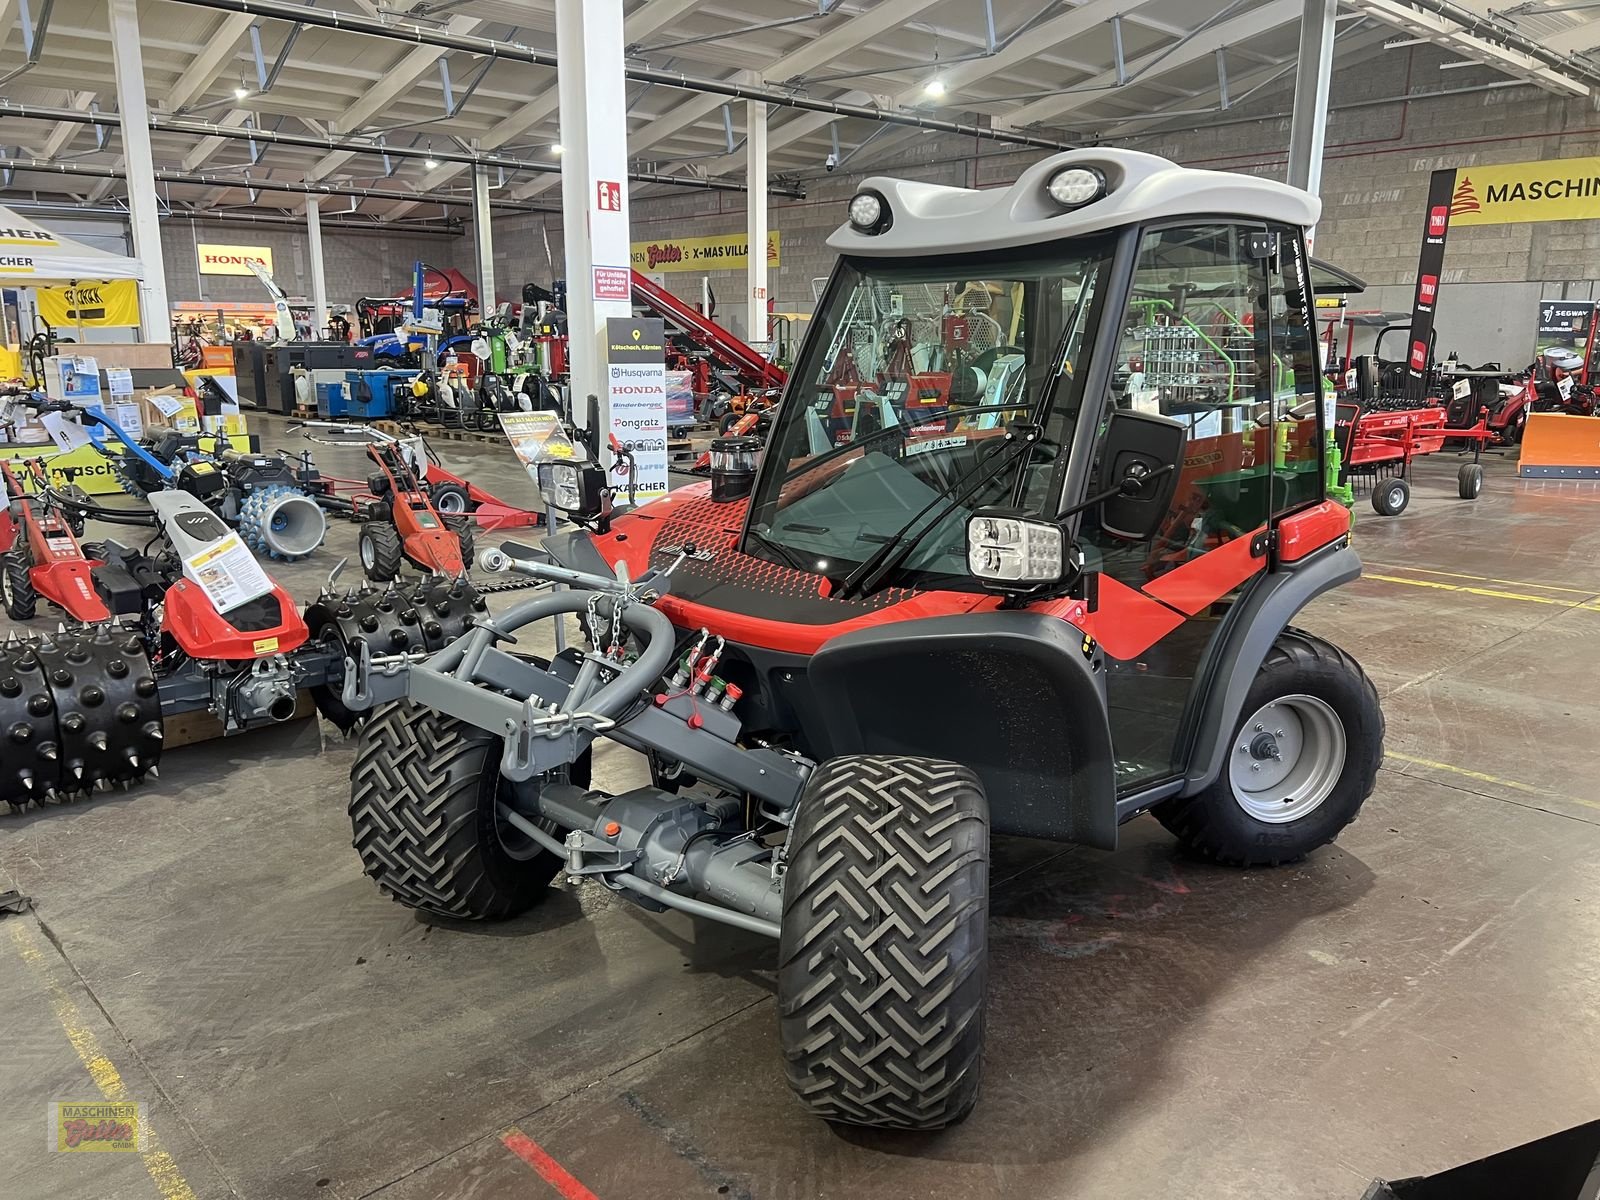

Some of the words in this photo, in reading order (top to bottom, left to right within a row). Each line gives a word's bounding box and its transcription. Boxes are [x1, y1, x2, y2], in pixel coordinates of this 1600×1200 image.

[621, 368, 663, 378] Husqvarna
[612, 386, 663, 394] HONDA
[614, 418, 659, 430] Pongratz
